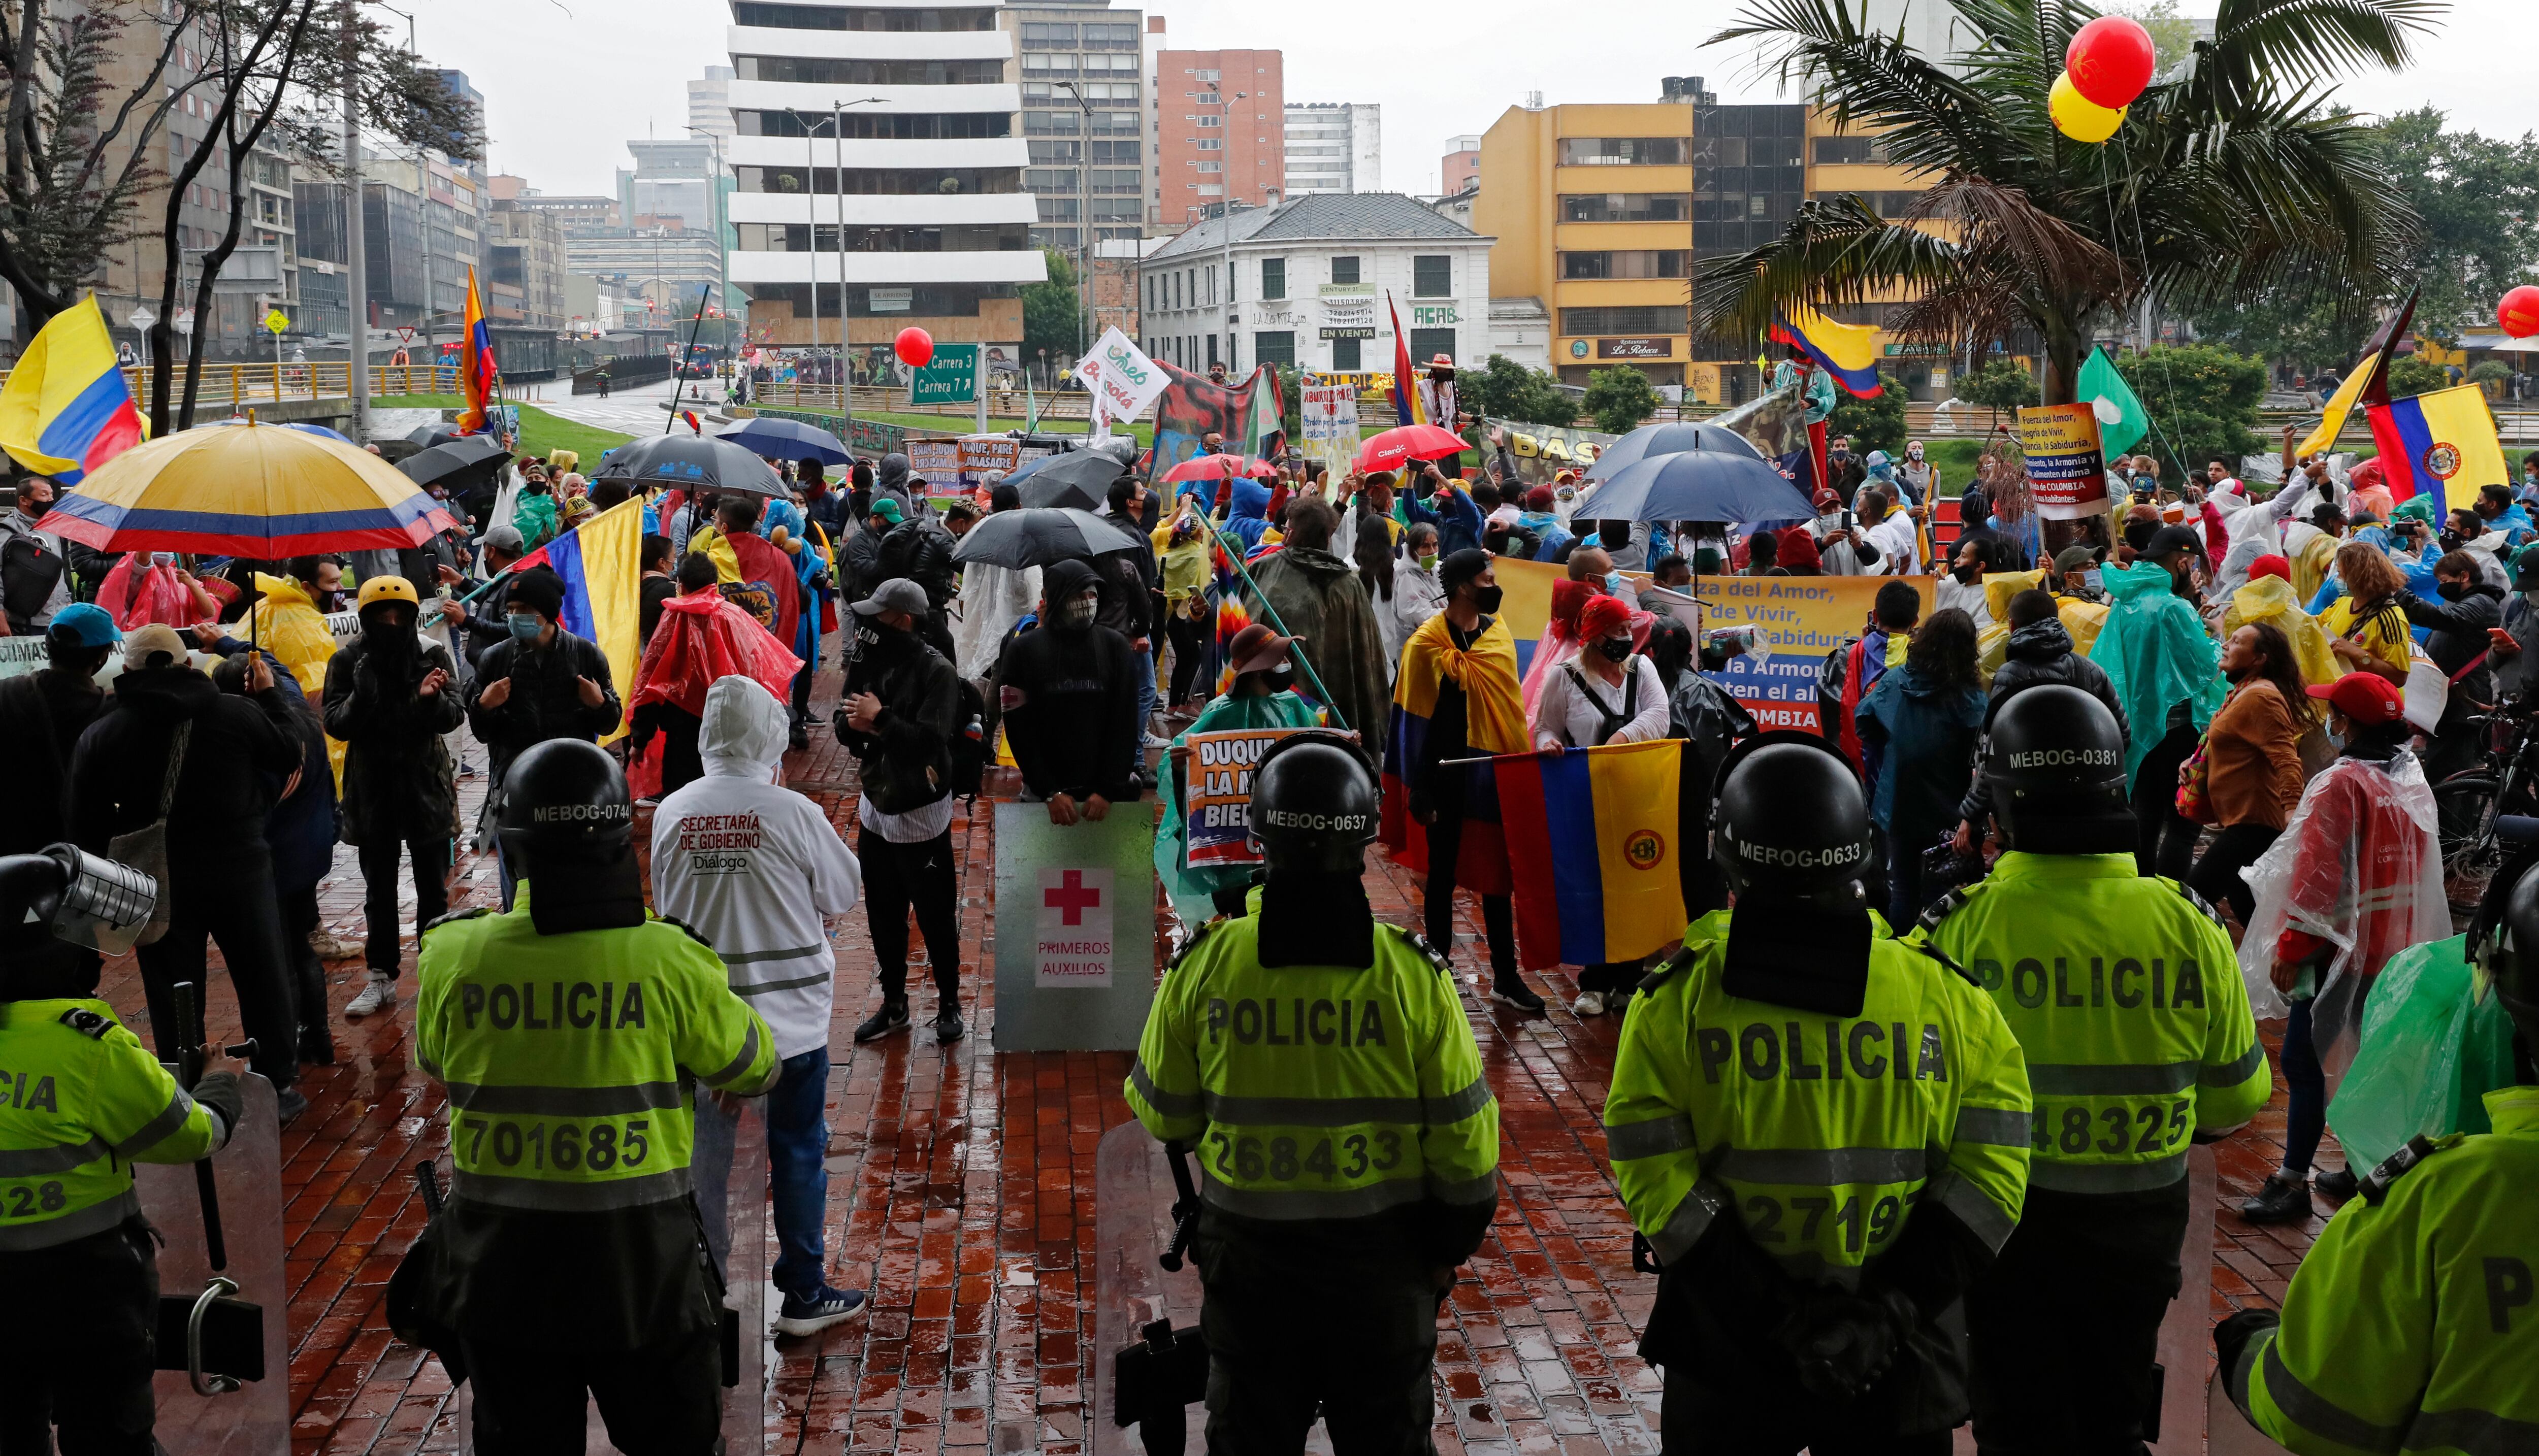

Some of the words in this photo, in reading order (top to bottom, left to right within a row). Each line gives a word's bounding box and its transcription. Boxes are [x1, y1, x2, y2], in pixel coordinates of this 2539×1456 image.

[1414, 307, 1457, 324] ACAB
[1338, 329, 1374, 338] VENTA
[1610, 345, 1626, 355] La
[1627, 344, 1658, 354] Rebeca
[932, 354, 963, 369] Carrera
[966, 354, 972, 369] 3
[918, 379, 951, 393] Carrera
[954, 378, 960, 392] 7
[2023, 416, 2041, 424] Fuerza
[2043, 414, 2052, 423] del
[2053, 414, 2076, 423] Amor,
[2048, 427, 2066, 437] Vivir,
[992, 443, 1013, 455] PARE
[1378, 445, 1405, 457] Claro
[2044, 442, 2049, 450] la
[2050, 438, 2092, 450] Sabiduría,
[2048, 458, 2054, 467] la
[2055, 456, 2088, 467] Armonía
[2089, 455, 2096, 464] y
[2068, 468, 2090, 477] alma
[2047, 481, 2086, 491] COLOMBIA
[2045, 493, 2079, 503] habitantes.
[1728, 581, 1761, 597] del
[1768, 583, 1835, 604] Amor,
[1710, 603, 1737, 619] de
[1744, 605, 1802, 626] Vivir,
[1727, 657, 1745, 674] la
[1768, 684, 1787, 700] el
[2009, 749, 2117, 769] MEBOG-0381
[1206, 771, 1233, 797] LA
[681, 810, 760, 832] SECRETARÍA
[1266, 809, 1367, 831] MEBOG-0637
[680, 835, 696, 850] DE
[699, 833, 760, 850] GOBIERNO
[693, 855, 747, 872] Diálogo
[1038, 942, 1111, 954] PRIMEROS
[1042, 963, 1105, 975] AUXILIOS
[462, 981, 646, 1031] POLICIA
[1208, 998, 1387, 1047] POLICIA
[1697, 1020, 1948, 1084] POLICIA
[463, 1117, 650, 1172] 701685
[1210, 1130, 1403, 1183] 268433
